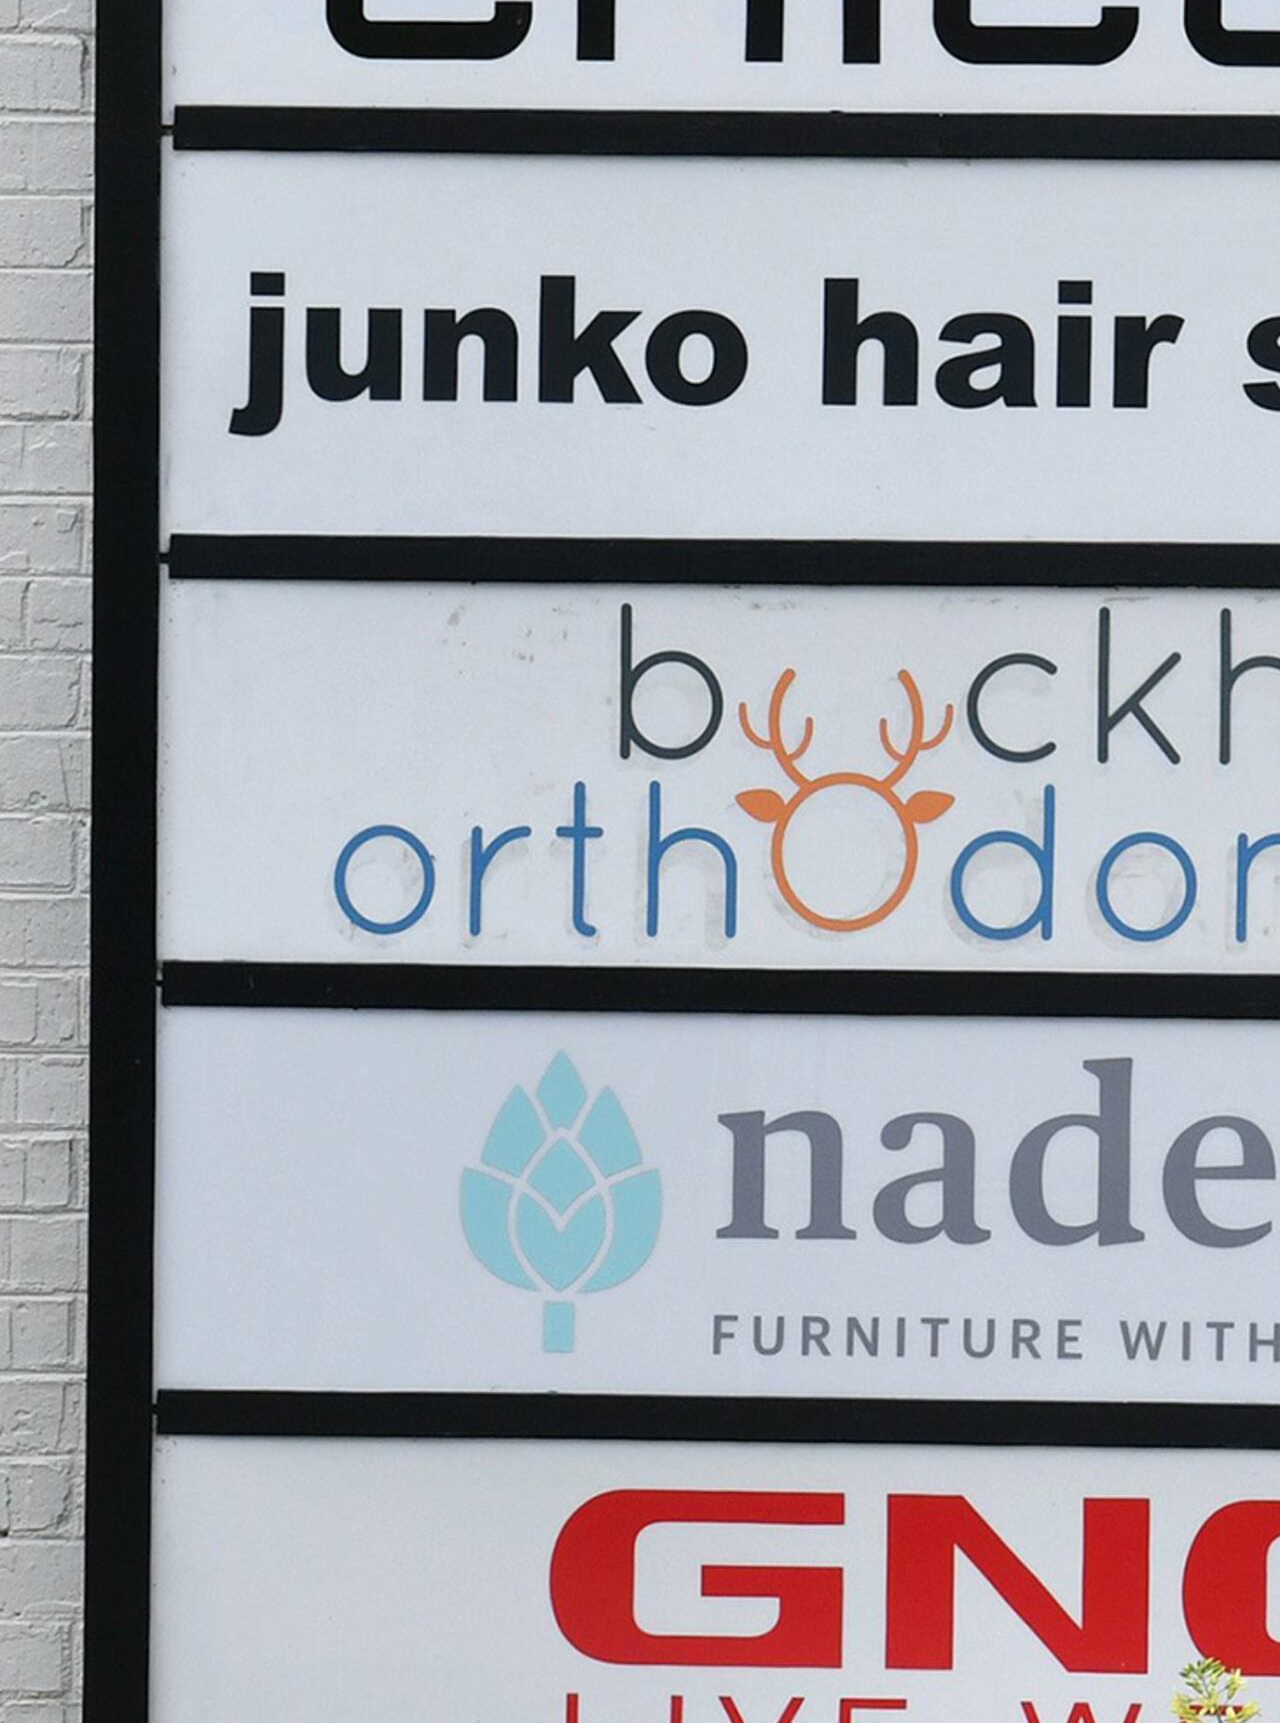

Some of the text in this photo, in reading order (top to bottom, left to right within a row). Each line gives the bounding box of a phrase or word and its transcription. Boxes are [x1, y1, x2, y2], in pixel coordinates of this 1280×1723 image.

[228, 272, 748, 437] junko
[822, 278, 1185, 409] hair
[714, 1316, 1081, 1358] FURNITURE
[1121, 1322, 1280, 1362] WITH
